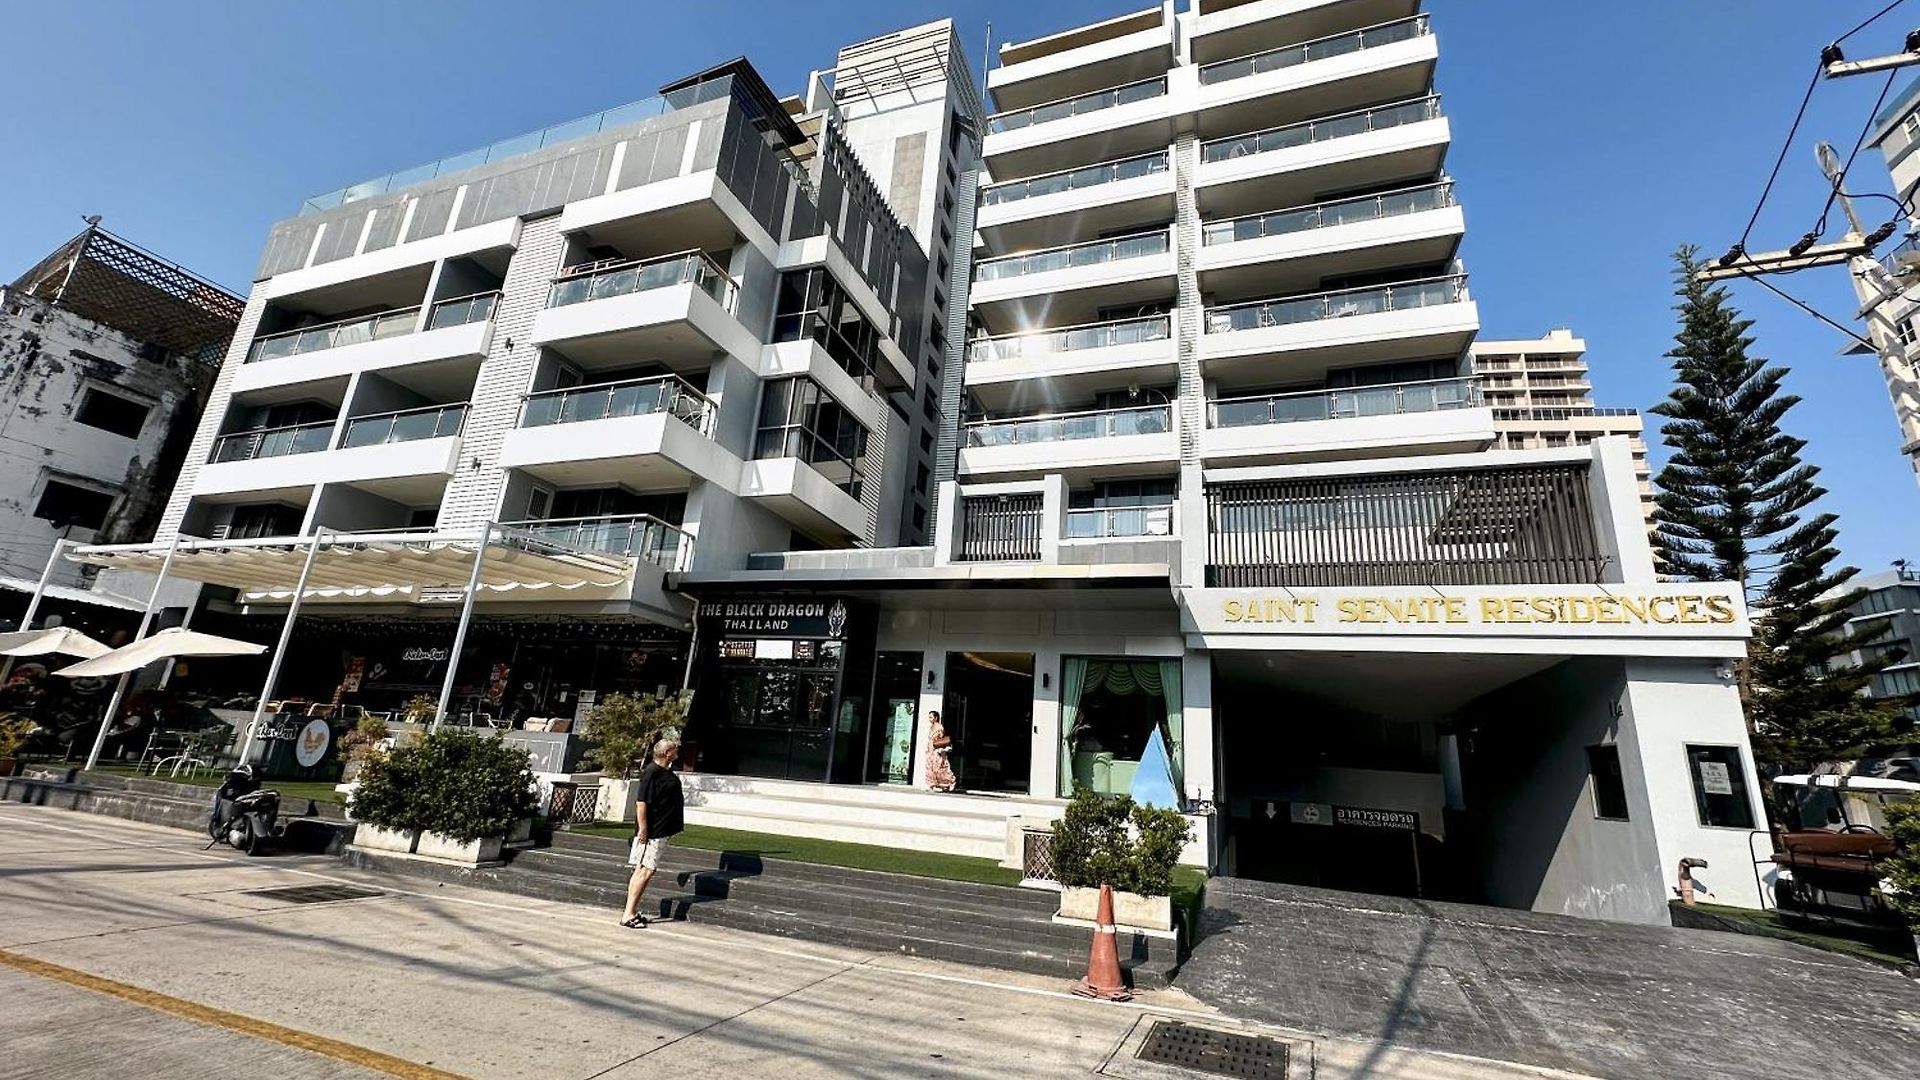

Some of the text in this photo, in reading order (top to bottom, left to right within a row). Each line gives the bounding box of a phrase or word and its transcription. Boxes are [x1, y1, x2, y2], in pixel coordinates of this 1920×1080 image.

[700, 603, 824, 617] THE BLACK DRAGON
[1223, 596, 1736, 624] SAINT SENATE RESIDENCES
[724, 619, 789, 630] THAILAND
[1337, 809, 1414, 823] อาคารจอดรถ
